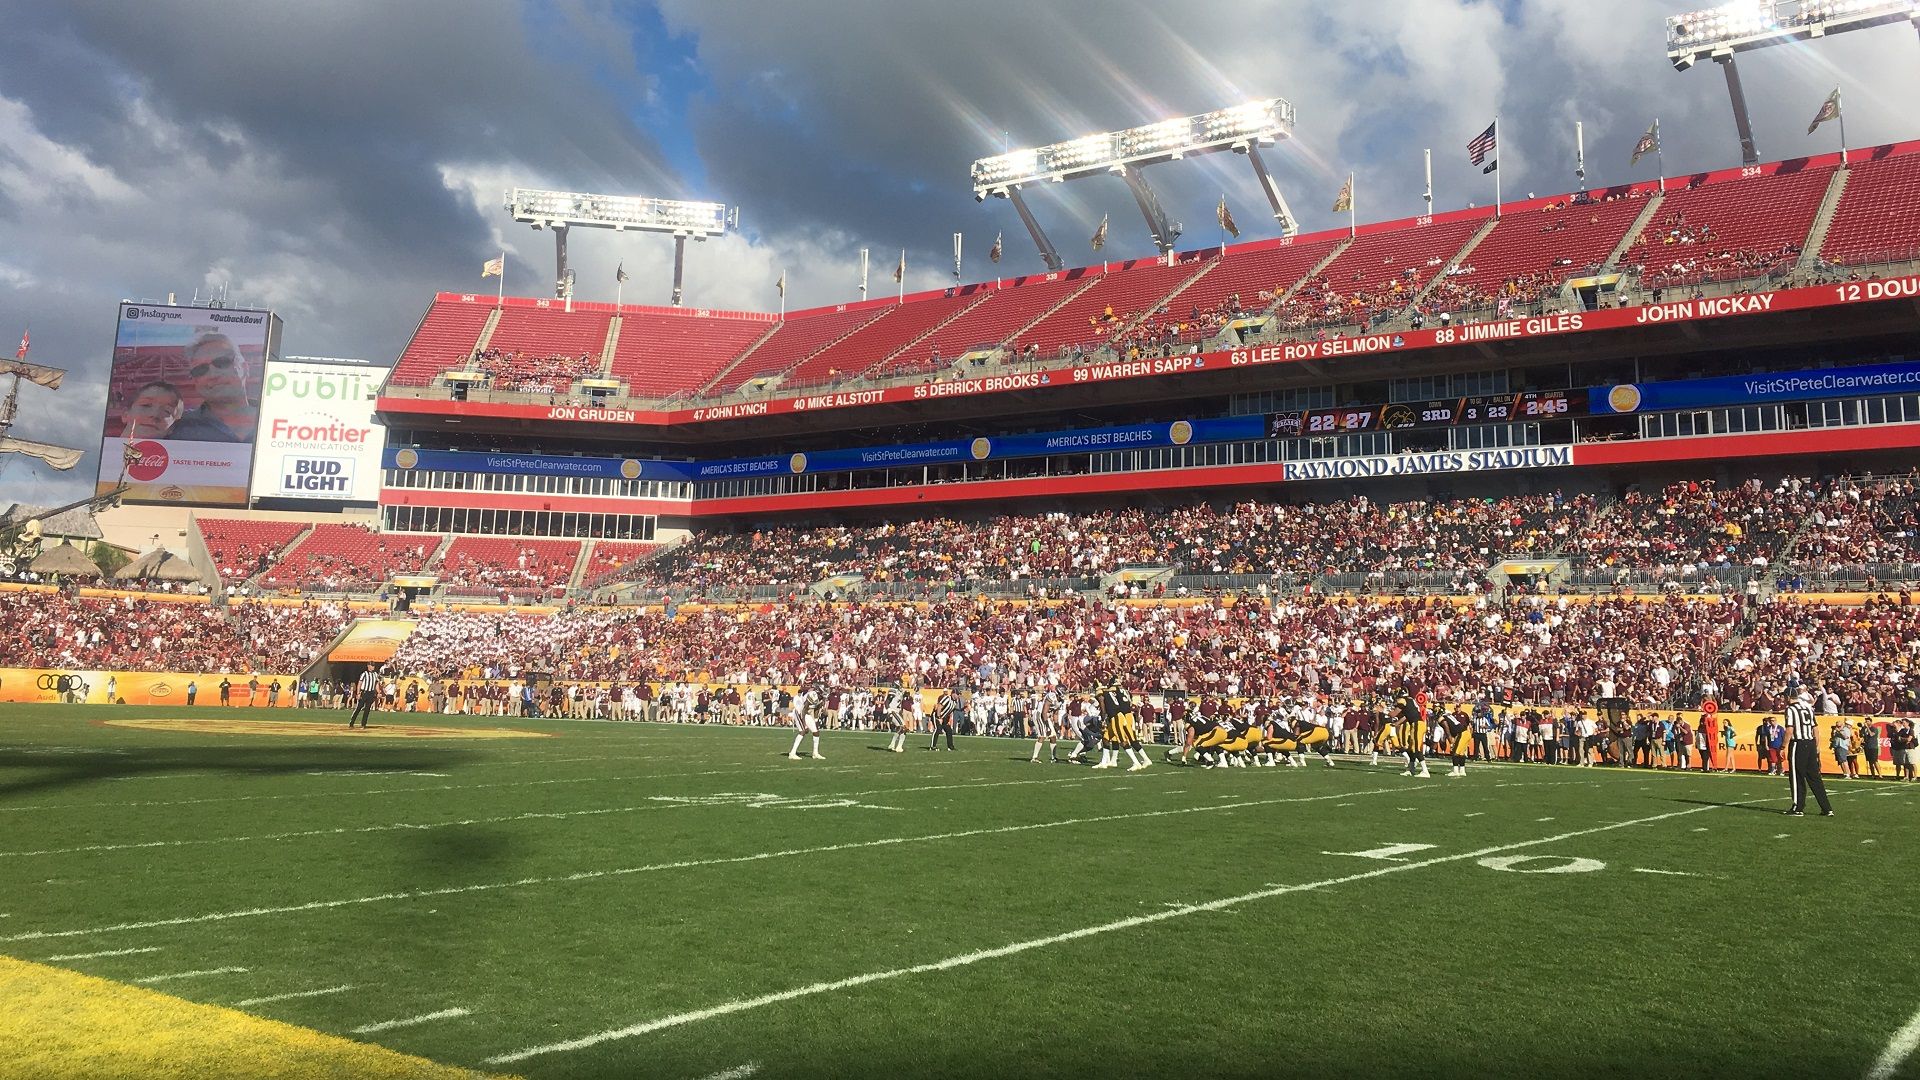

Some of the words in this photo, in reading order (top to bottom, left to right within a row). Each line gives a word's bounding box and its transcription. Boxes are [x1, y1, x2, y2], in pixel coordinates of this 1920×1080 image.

[1742, 166, 1762, 177] 334
[1570, 193, 1588, 202] 335
[1417, 217, 1432, 225] 336
[1280, 237, 1294, 246] 337
[1836, 284, 1861, 301] 12
[1867, 278, 1920, 299] DOU
[140, 309, 182, 321] Instagram
[1636, 303, 1693, 323] JOHN
[1699, 293, 1774, 317] MCKAY
[210, 314, 263, 325] #OutbackBowl
[1435, 329, 1455, 344] 88
[1459, 321, 1522, 341] JIMMIE
[1526, 315, 1583, 334] GILES
[1231, 351, 1247, 365] 63
[1252, 347, 1280, 363] LEE
[1285, 343, 1318, 359] ROY
[1322, 336, 1390, 356] SELMON
[1073, 368, 1088, 381] 99
[1091, 361, 1151, 380] WARREN
[1154, 357, 1192, 373] SAPP
[914, 386, 927, 398] 55
[930, 379, 982, 396] DERRICK
[985, 374, 1039, 390] BROOKS
[793, 399, 805, 410] 40
[807, 395, 834, 409] MIKE
[835, 390, 885, 406] ALSTOTT
[1526, 399, 1568, 415] 2:45
[547, 408, 576, 420] JON
[578, 409, 635, 422] GRUDEN
[693, 410, 704, 421] 47
[706, 406, 732, 419] JOHN
[733, 402, 767, 417] LYNCH
[1422, 409, 1451, 421] 3RD
[1467, 408, 1477, 419] 3
[1488, 406, 1507, 418] 23
[1310, 414, 1335, 431] 22
[1346, 412, 1371, 429] 27
[271, 418, 371, 443] Frontier
[270, 441, 364, 452] COMMUNICATIONS
[1046, 434, 1089, 448] AMERICA'S
[1091, 432, 1112, 444] BEST
[1113, 430, 1153, 442] BEACHES
[861, 447, 958, 462] VisitStPeteClearwater.com
[295, 459, 342, 475] BUD
[487, 457, 602, 473] VisitStPeteClearwater.com
[700, 464, 732, 475] AMERICA'S
[733, 462, 749, 473] BEST
[749, 460, 778, 471] BEACHES
[1284, 459, 1388, 481] RAYMOND
[1390, 453, 1463, 475] JAMES
[1468, 446, 1571, 471] STADIUM
[284, 475, 349, 491] LIGHT
[1801, 708, 1811, 725] C
[1320, 842, 1607, 874] 10
